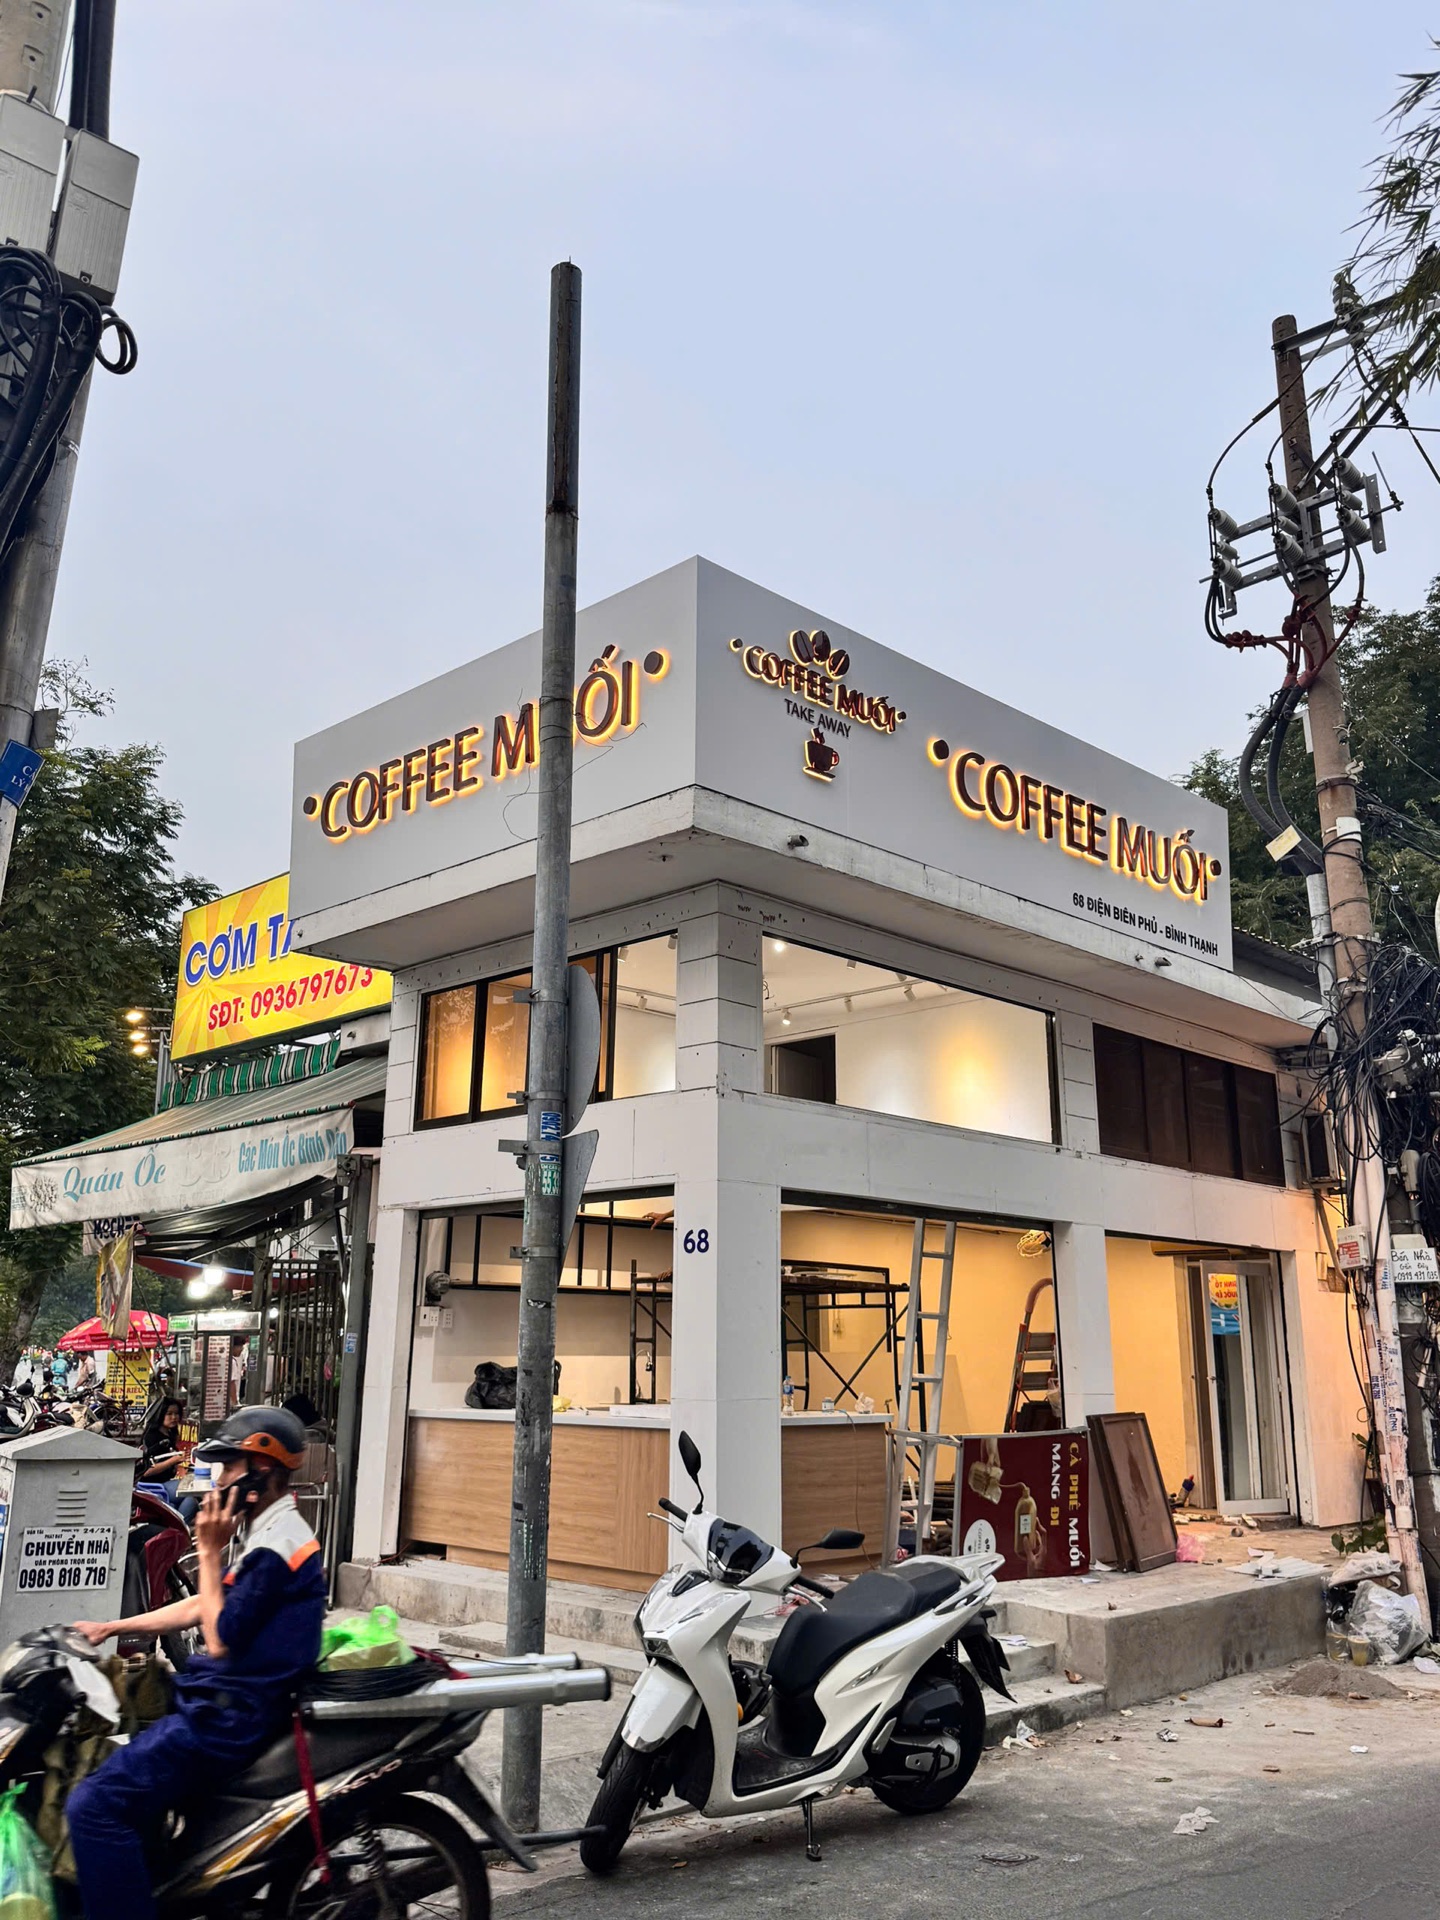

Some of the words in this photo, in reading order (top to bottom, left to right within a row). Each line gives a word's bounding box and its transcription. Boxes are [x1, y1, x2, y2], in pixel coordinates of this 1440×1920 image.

[745, 646, 833, 707] COFFEE
[836, 684, 896, 733] MUỐI
[320, 726, 480, 838] COFFEE
[491, 643, 633, 777] MỐI
[784, 699, 815, 724] TAKE
[818, 713, 851, 738] AWAY
[954, 751, 1109, 862] COFFEE
[1116, 816, 1209, 901] MUỐI
[1073, 892, 1085, 908] 68
[1087, 897, 1111, 917] ĐIỆN
[1113, 906, 1136, 926] BIÊN
[1138, 915, 1158, 934] PHỦ
[1165, 924, 1187, 945] BÌNH
[1188, 934, 1218, 956] THẠNH
[185, 923, 258, 985] CƠM
[208, 997, 245, 1030] SĐT:
[251, 963, 374, 1019] 0936797673
[63, 1166, 124, 1202] Quán
[134, 1144, 167, 1187] Ốc
[239, 1141, 257, 1173] Các
[258, 1136, 280, 1170] Món
[282, 1126, 295, 1168] Ốc
[683, 1229, 709, 1254] 68
[1391, 1250, 1409, 1262] Bán
[1413, 1249, 1432, 1261] Nhà
[1051, 1443, 1061, 1500] MANG
[1069, 1442, 1082, 1467] CÀ
[1050, 1505, 1059, 1525] ĐI
[1069, 1474, 1081, 1511] PHÊ
[25, 1534, 85, 1556] CHUYỂN
[87, 1537, 109, 1554] NHÀ
[1068, 1517, 1085, 1567] MUỐI
[19, 1568, 54, 1589] 0983
[58, 1567, 81, 1587] 818
[84, 1566, 106, 1586] 718
